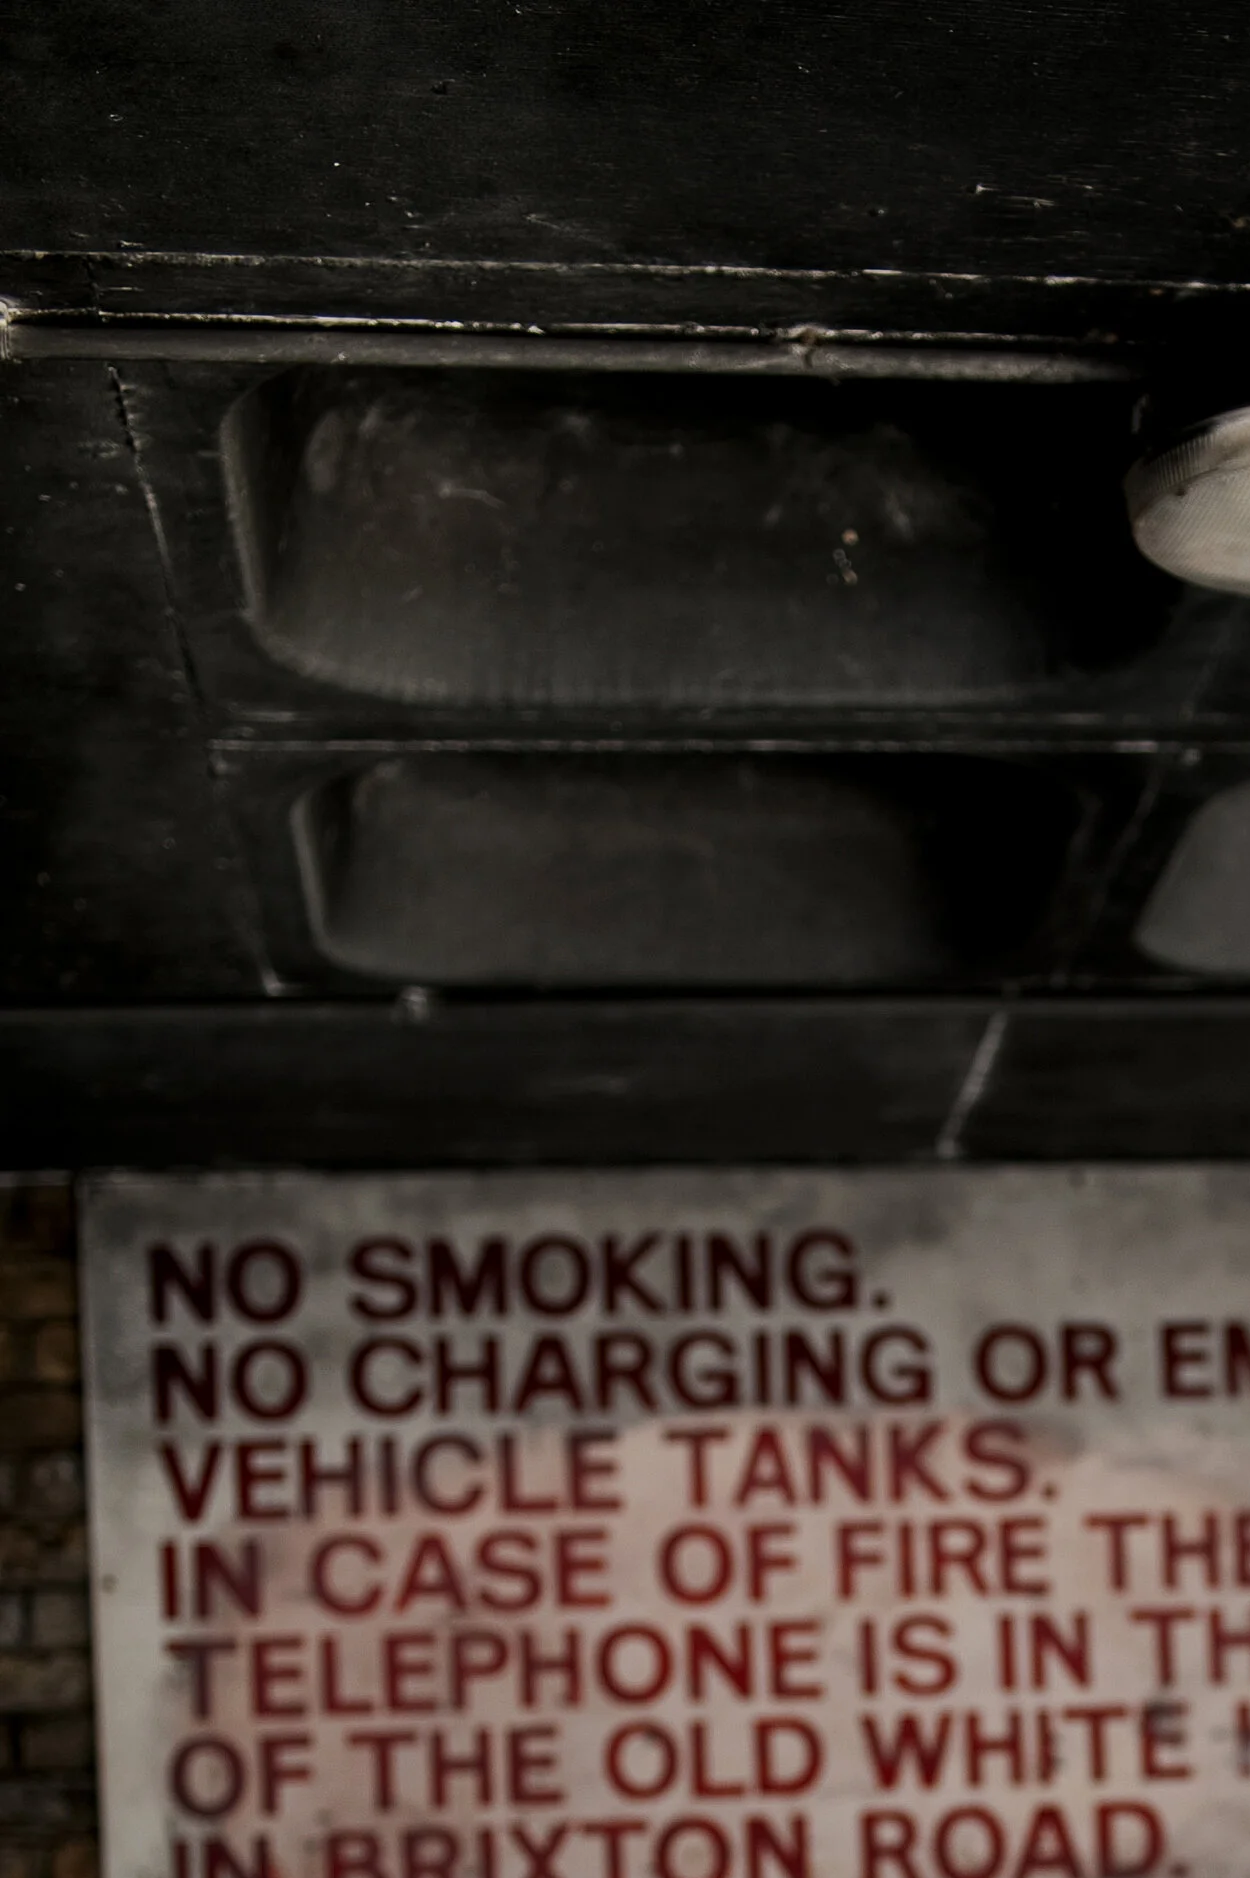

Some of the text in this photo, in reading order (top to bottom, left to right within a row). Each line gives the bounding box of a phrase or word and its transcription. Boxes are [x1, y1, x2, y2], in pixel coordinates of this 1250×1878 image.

[149, 1227, 890, 1325] NO SMOKING.
[153, 1337, 306, 1425] NO
[349, 1325, 934, 1416] CHARGING
[973, 1320, 1121, 1404] OR
[160, 1418, 1058, 1522] VEHICLE TANKS.
[161, 1537, 261, 1622] IN
[311, 1527, 610, 1619] CASE
[659, 1520, 797, 1602] OF
[836, 1514, 1050, 1600] FIRE
[164, 1618, 824, 1721] TELEPHONE
[860, 1614, 957, 1696] IS
[996, 1610, 1093, 1693] IN
[170, 1733, 315, 1821] OF
[346, 1723, 567, 1812] THE
[604, 1714, 823, 1801] OLD
[860, 1701, 1192, 1788] WHITE
